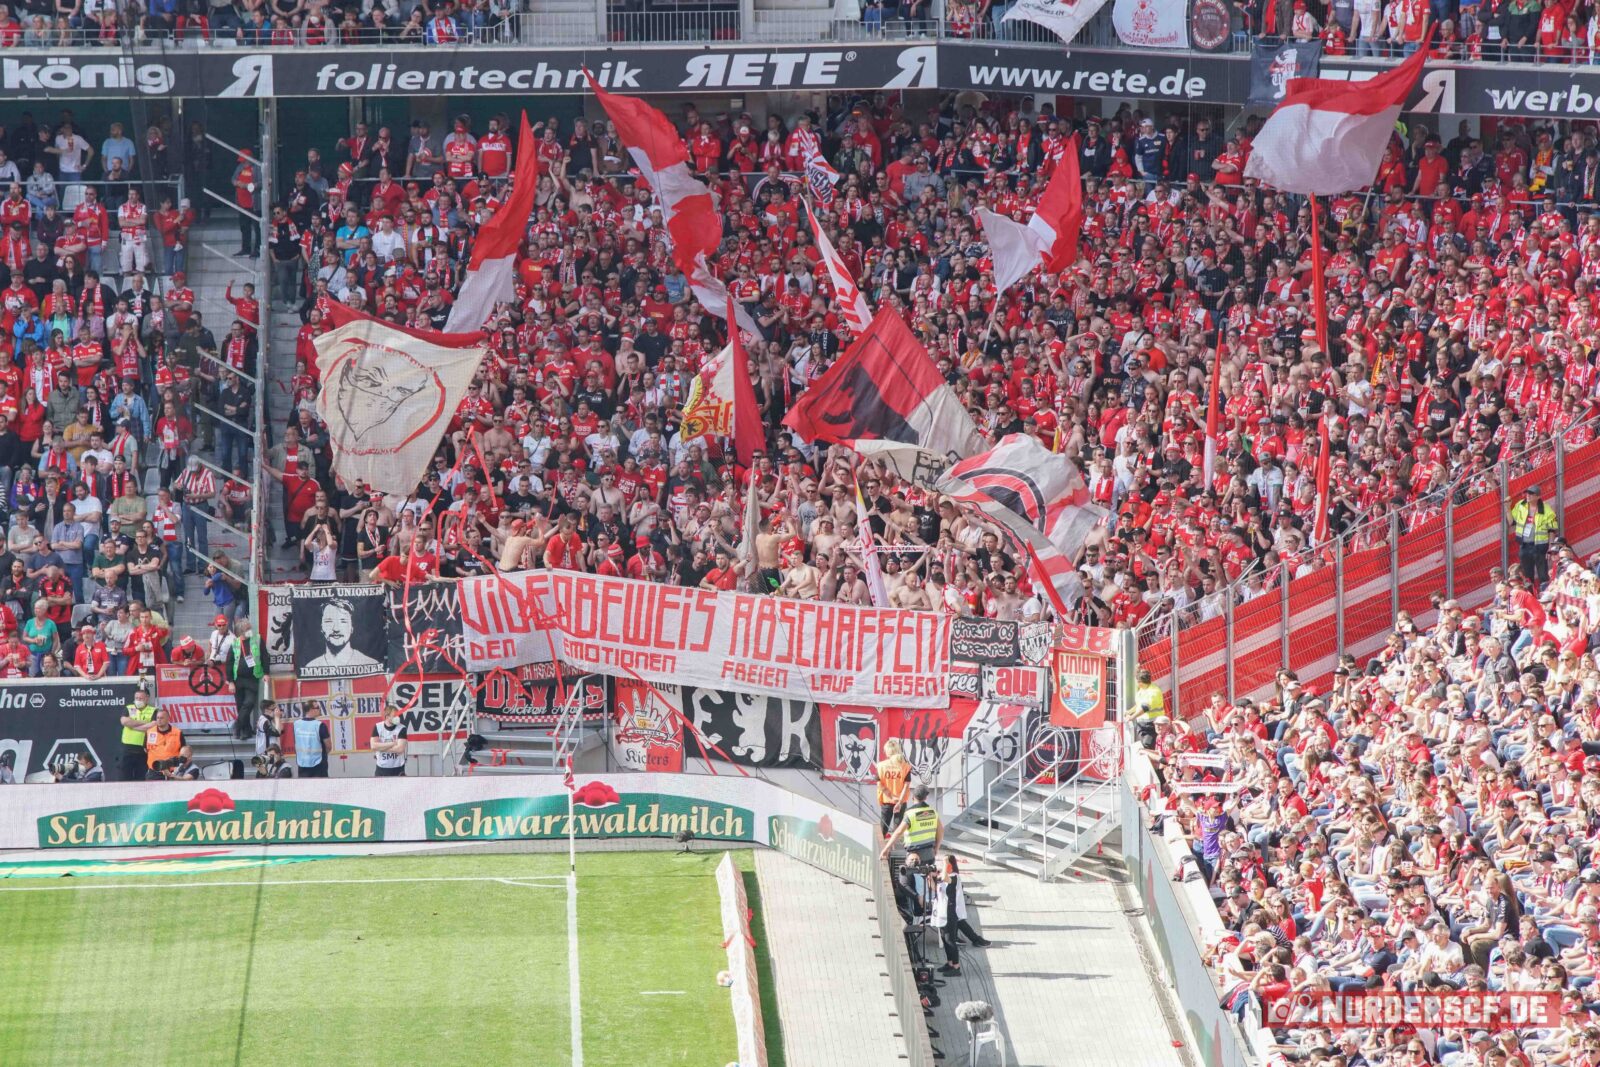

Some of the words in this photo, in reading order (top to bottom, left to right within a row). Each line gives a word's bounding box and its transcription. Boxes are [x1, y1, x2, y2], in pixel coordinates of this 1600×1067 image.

[3, 57, 174, 94] könig
[316, 62, 642, 91] folientechnik
[968, 64, 1207, 98] www.rete.de
[1490, 84, 1600, 113] werb
[293, 587, 334, 598] EINMAL
[300, 665, 336, 676] IMMER
[339, 662, 384, 675] UNIONER
[1060, 654, 1099, 675] UNION
[59, 697, 125, 708] Schwarzwald
[71, 689, 98, 697] Made
[101, 688, 113, 696] im
[396, 683, 467, 709] SEK
[48, 809, 374, 845] Schwarzwaldmilch
[434, 804, 745, 839] Schwarzwaldmilch
